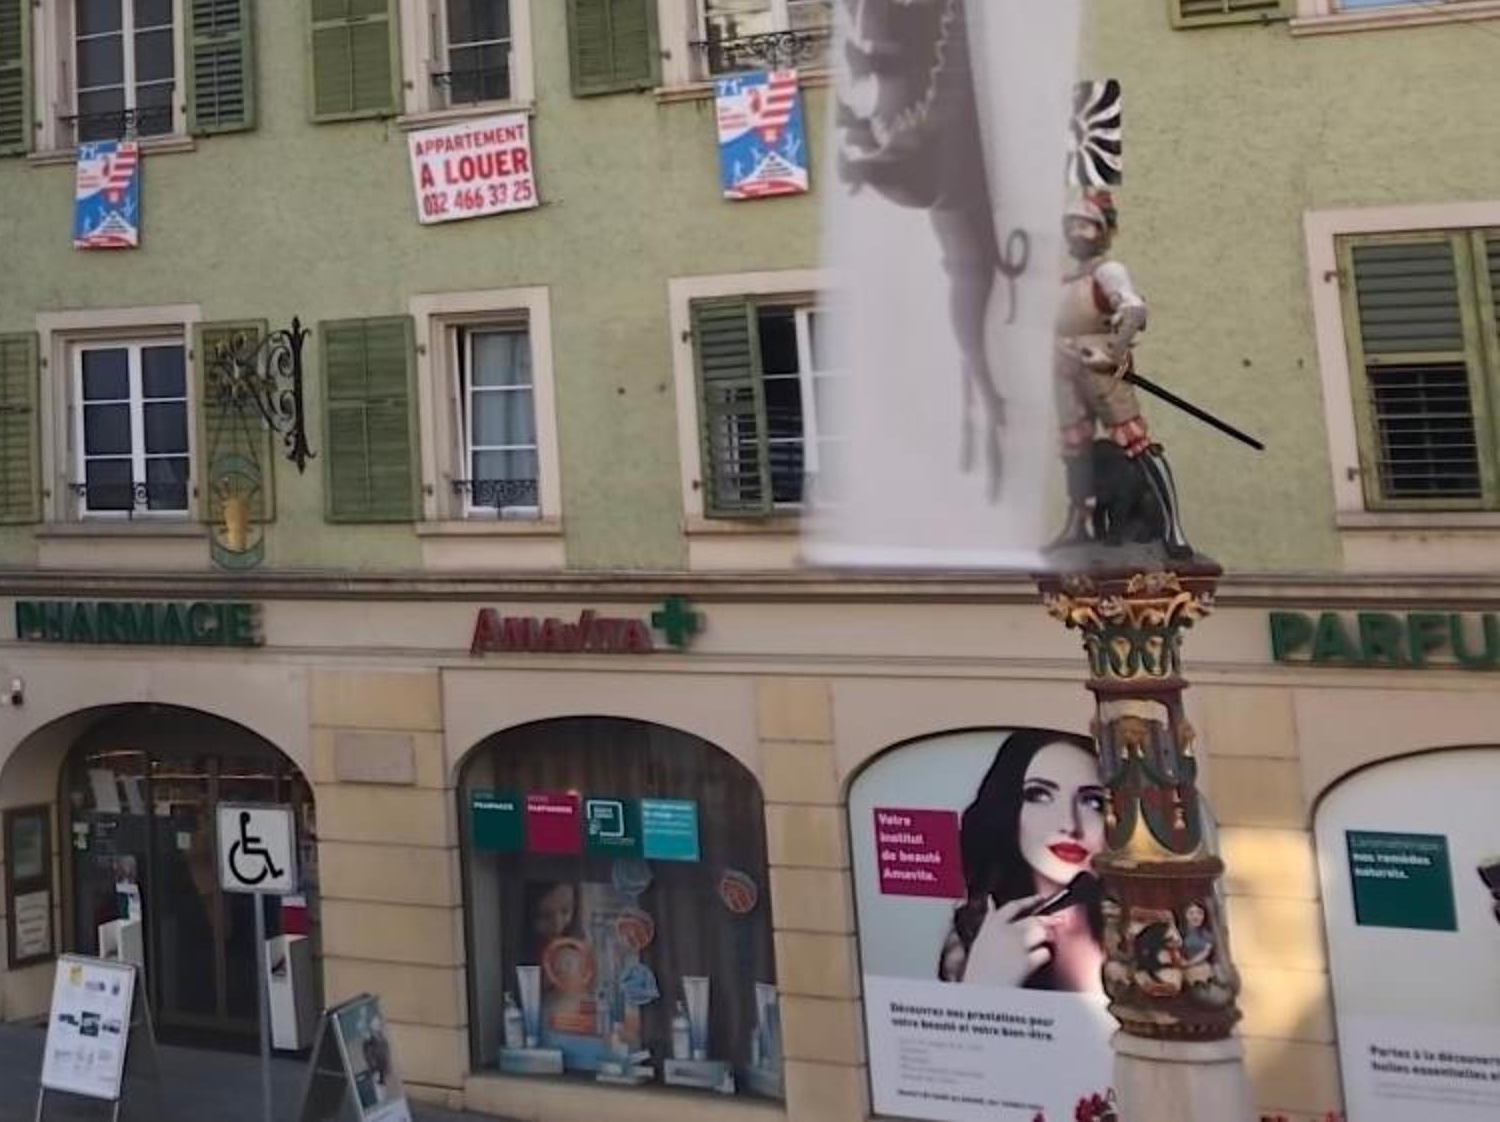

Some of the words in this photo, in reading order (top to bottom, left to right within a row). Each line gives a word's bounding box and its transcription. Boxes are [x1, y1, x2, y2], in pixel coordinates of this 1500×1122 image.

[415, 124, 524, 157] APPARTEMENT
[420, 162, 435, 189] A
[444, 147, 529, 185] LOUER
[15, 601, 264, 646] PHARMACIE
[879, 813, 911, 826] Votre
[882, 849, 896, 861] de
[899, 849, 941, 863] beauté
